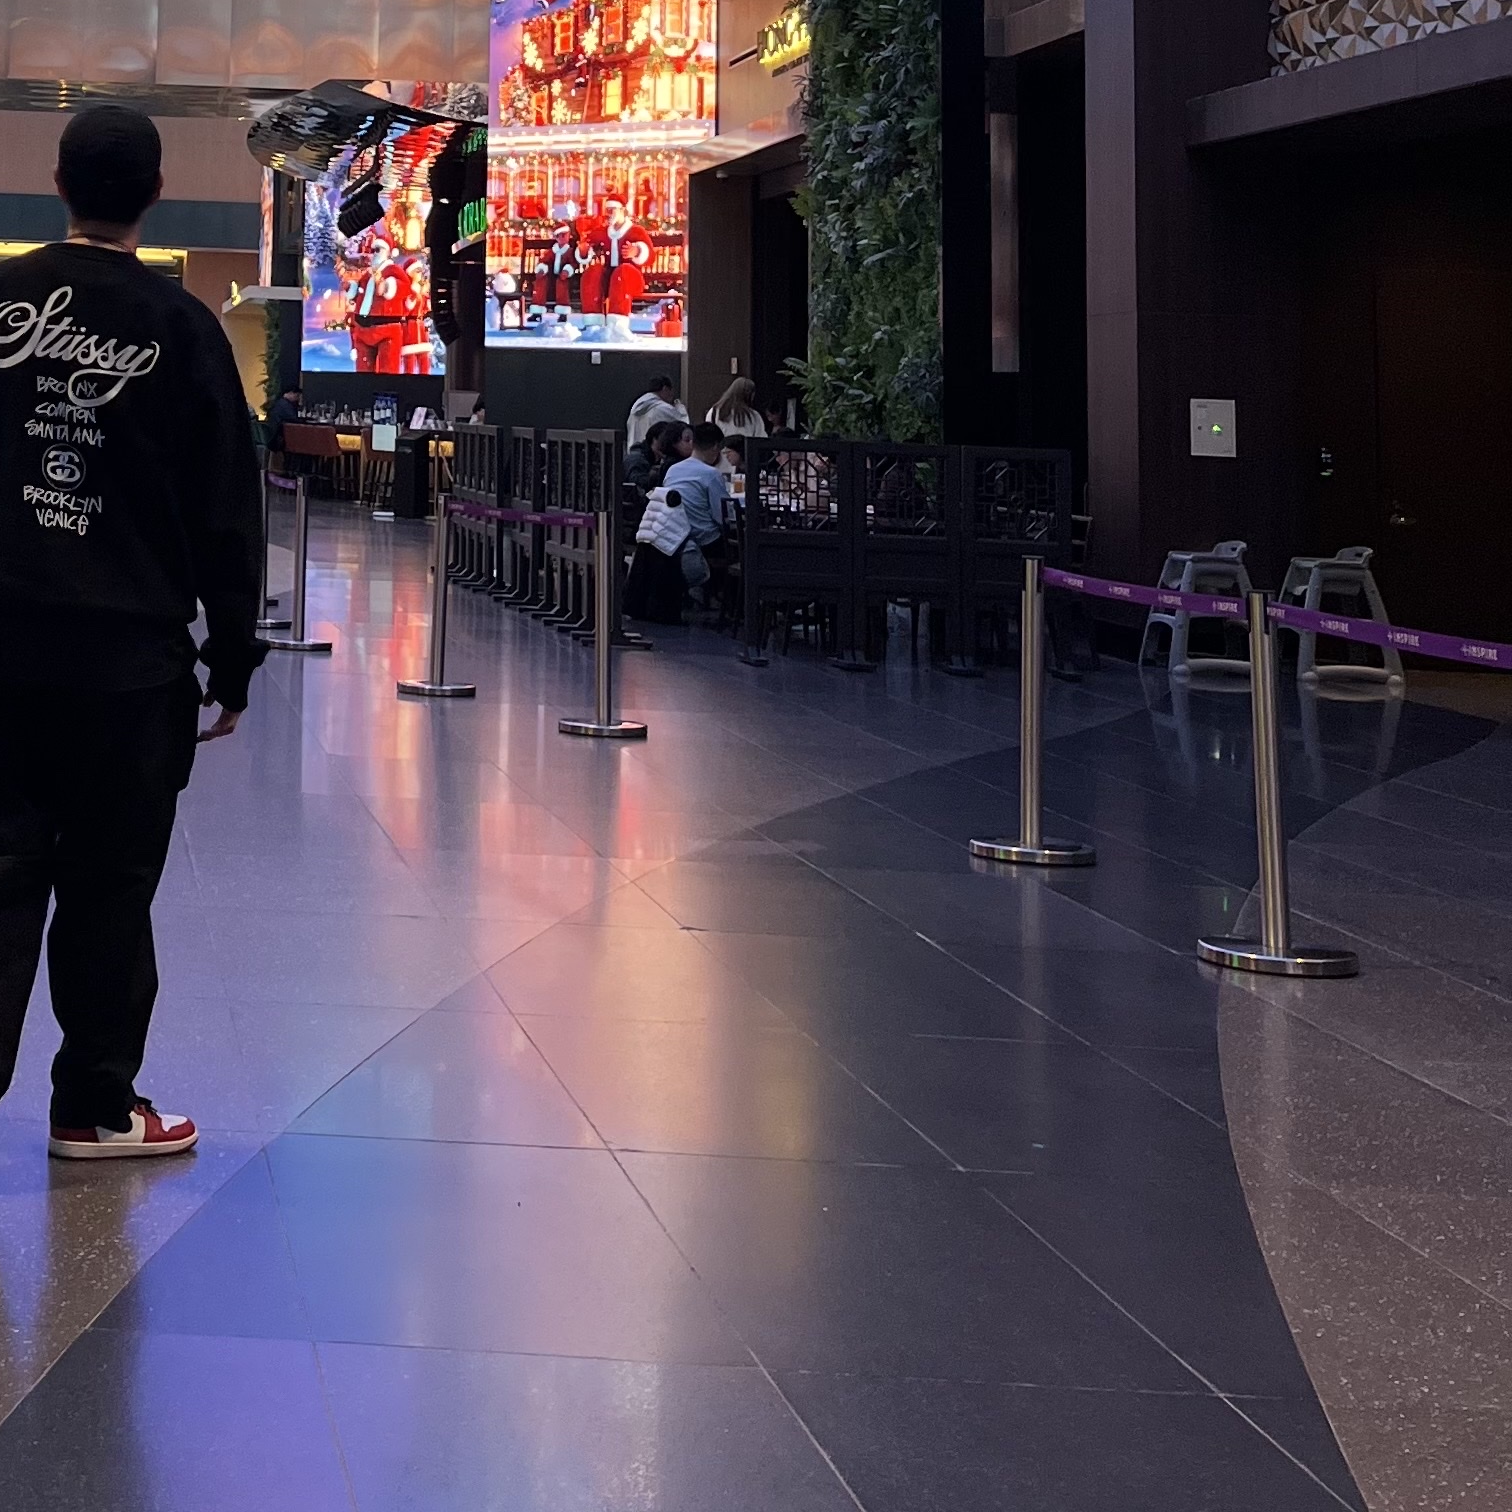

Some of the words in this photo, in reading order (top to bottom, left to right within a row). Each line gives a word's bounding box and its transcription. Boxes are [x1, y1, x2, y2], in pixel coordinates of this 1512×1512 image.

[35, 401, 97, 424] COMPTON
[24, 419, 69, 442] SANTA
[72, 426, 106, 448] ANA
[23, 485, 102, 514] BROOKLYN
[1325, 620, 1349, 634] INSPIRE
[1393, 632, 1420, 647] INSPIRE
[1470, 646, 1498, 661] INSPIRE
